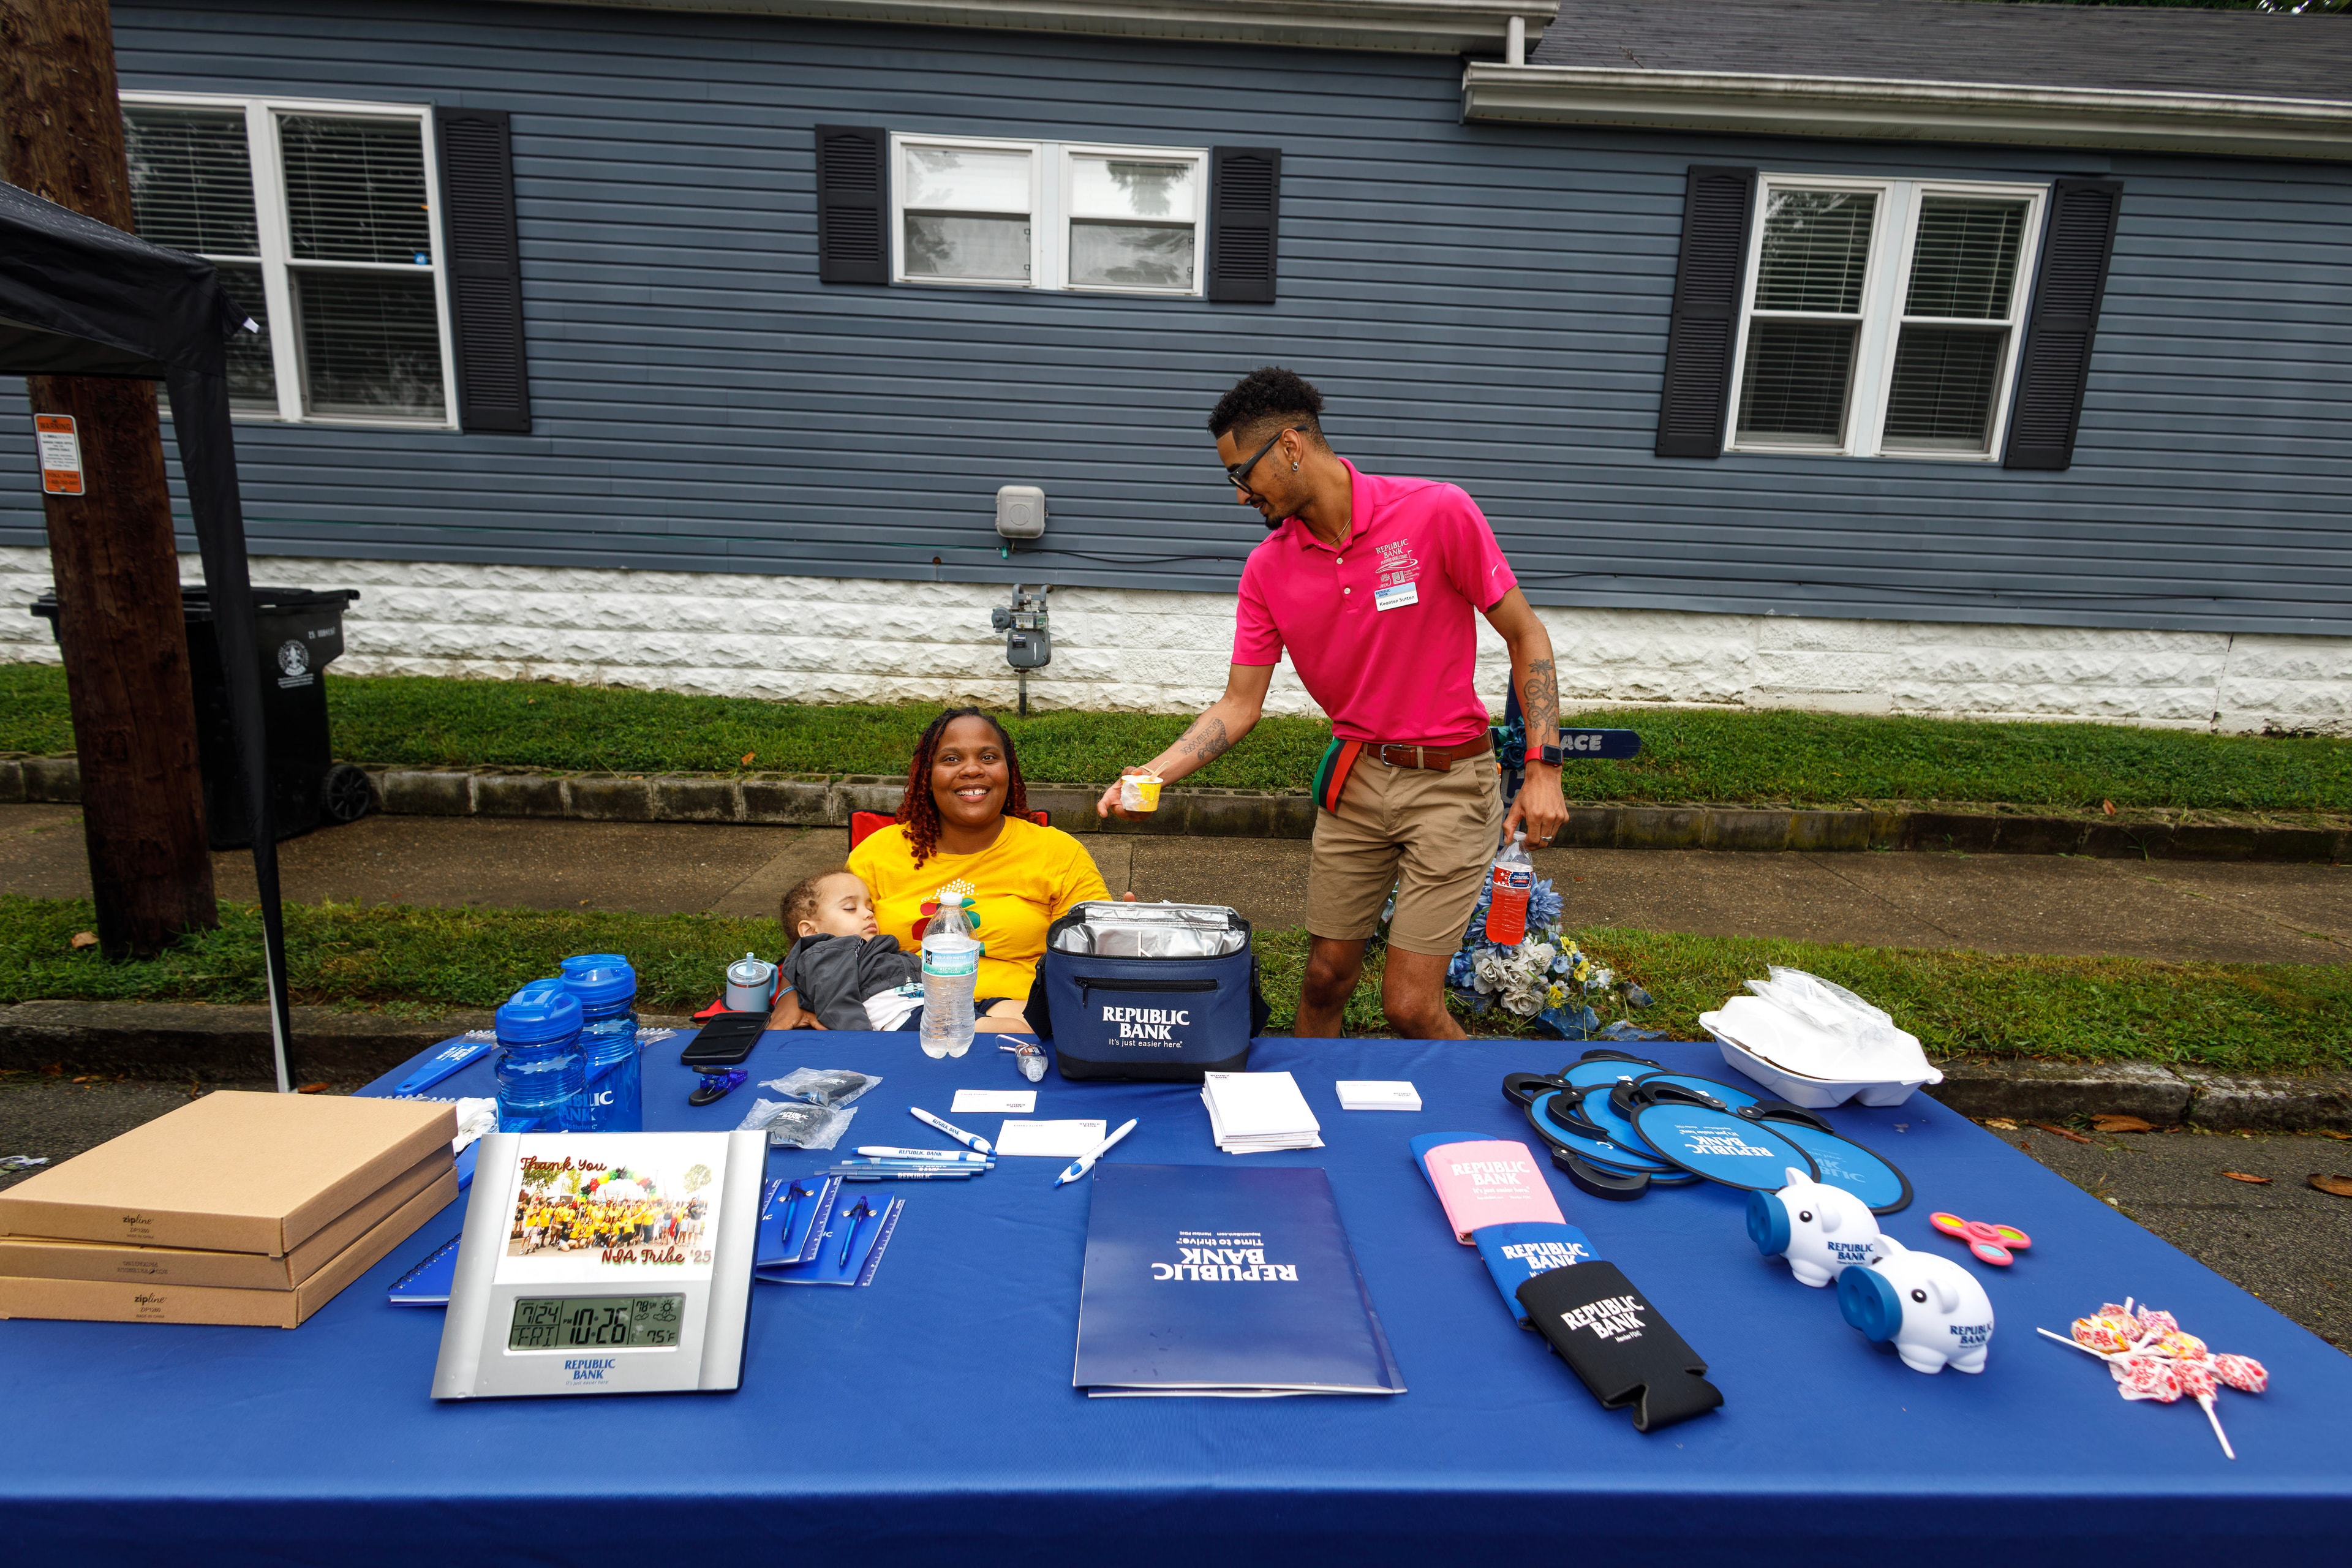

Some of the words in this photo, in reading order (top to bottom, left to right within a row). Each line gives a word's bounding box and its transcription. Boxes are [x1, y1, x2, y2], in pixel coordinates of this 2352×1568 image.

[1376, 538, 1409, 554] REPUBLIC
[1384, 547, 1403, 559] BANK
[1102, 1006, 1190, 1025] REPUBLIC
[1120, 1023, 1172, 1040] BANK
[1121, 1039, 1136, 1047] just
[932, 1118, 949, 1130] REPUBLIC
[1690, 1136, 1747, 1147] BANK
[1684, 1144, 1775, 1157] REPUBLIC
[520, 1156, 575, 1172] Thank
[578, 1159, 608, 1172] You
[1450, 1161, 1530, 1176] REPUBLIC
[1471, 1172, 1521, 1185] BANK
[123, 1214, 153, 1226] zipline
[1501, 1242, 1589, 1259] REPUBLIC
[1828, 1241, 1874, 1253] REPUBLIC
[601, 1248, 638, 1265] NIA
[641, 1246, 685, 1265] Tribe
[1179, 1248, 1266, 1265] BANK
[1525, 1254, 1578, 1270] BANK
[1838, 1251, 1865, 1261] BANK
[1151, 1262, 1298, 1281] REPUBLIC
[134, 1292, 165, 1306] zipline
[636, 1300, 649, 1312] 78
[522, 1303, 559, 1324] 7/24
[1560, 1295, 1645, 1331] REPUBLIC
[569, 1307, 628, 1344] 10:26
[1589, 1311, 1646, 1340] BANK
[518, 1327, 555, 1347] FRI
[1615, 1333, 1632, 1343] Member
[1630, 1330, 1643, 1338] FDIC
[564, 1358, 616, 1370] REPUBLIC
[573, 1369, 604, 1380] BANK
